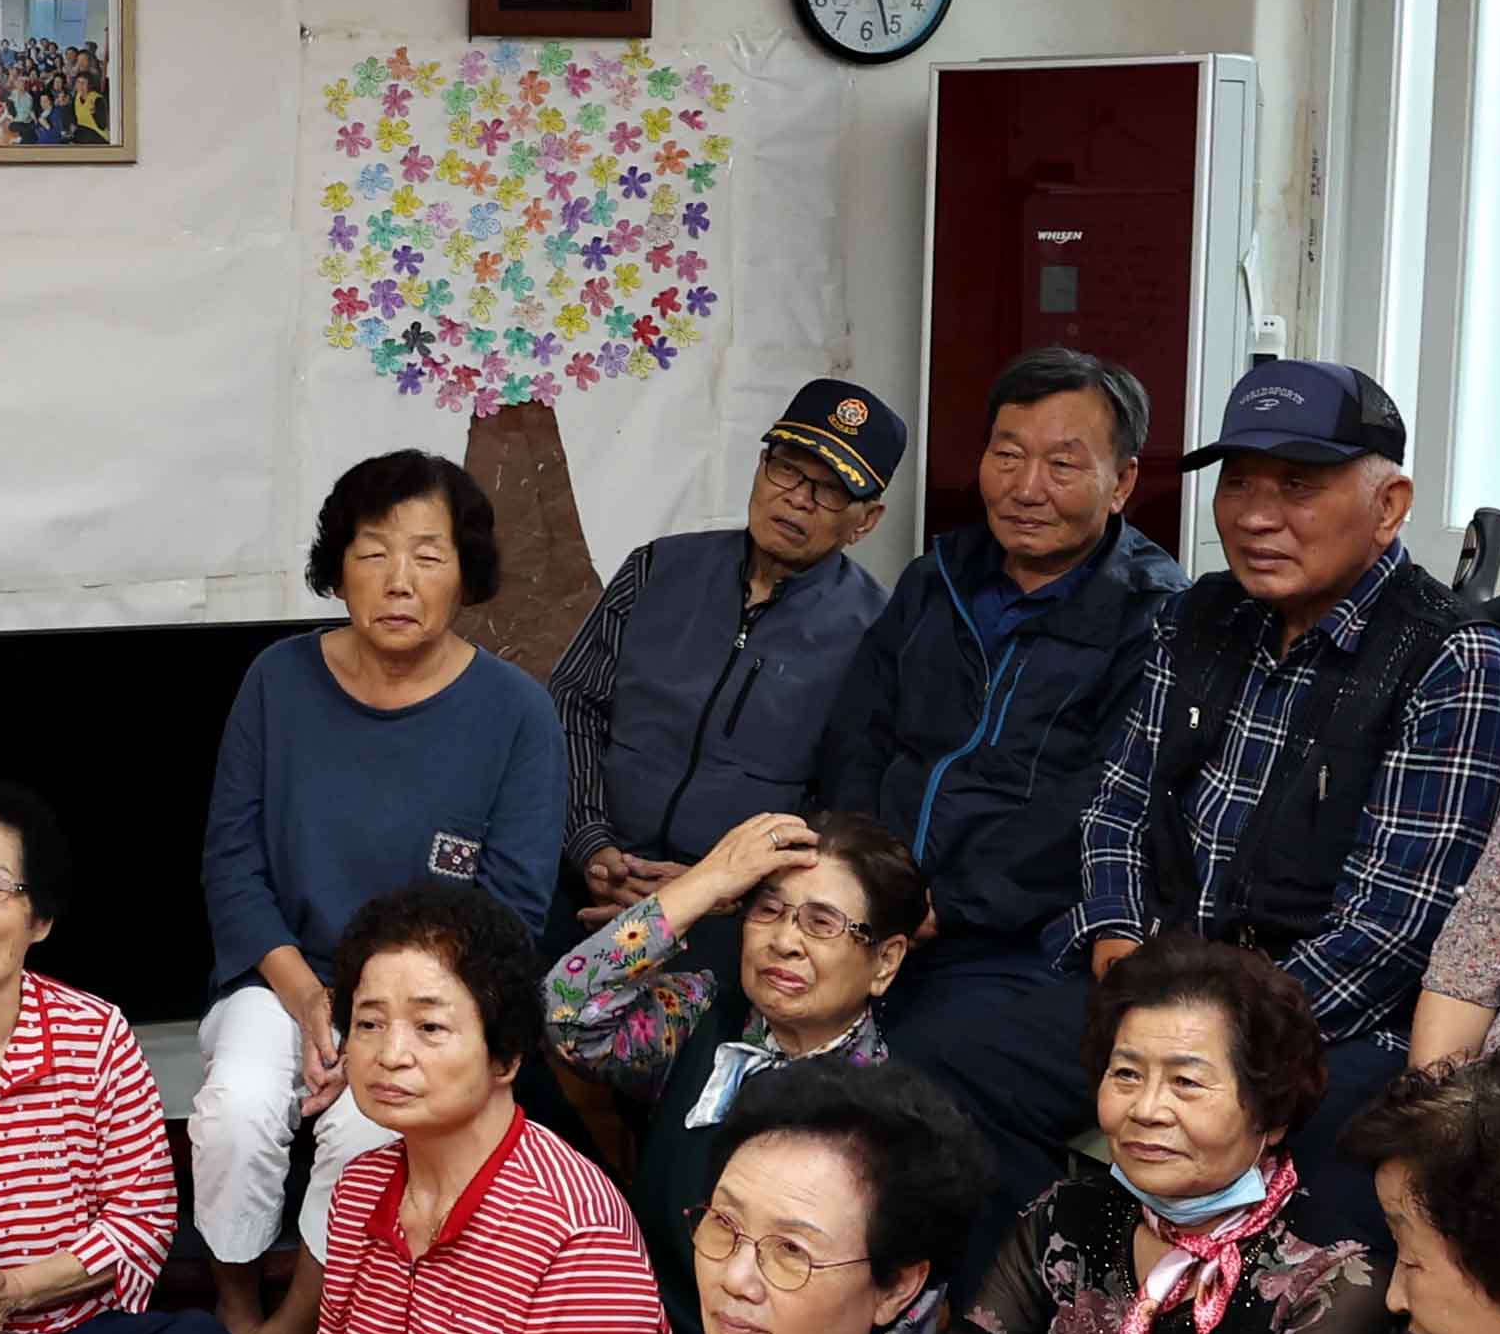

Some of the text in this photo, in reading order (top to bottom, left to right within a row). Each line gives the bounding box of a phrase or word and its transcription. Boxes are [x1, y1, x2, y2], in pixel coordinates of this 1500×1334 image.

[834, 11, 848, 31] 7
[860, 20, 873, 41] 6
[889, 14, 902, 34] 5
